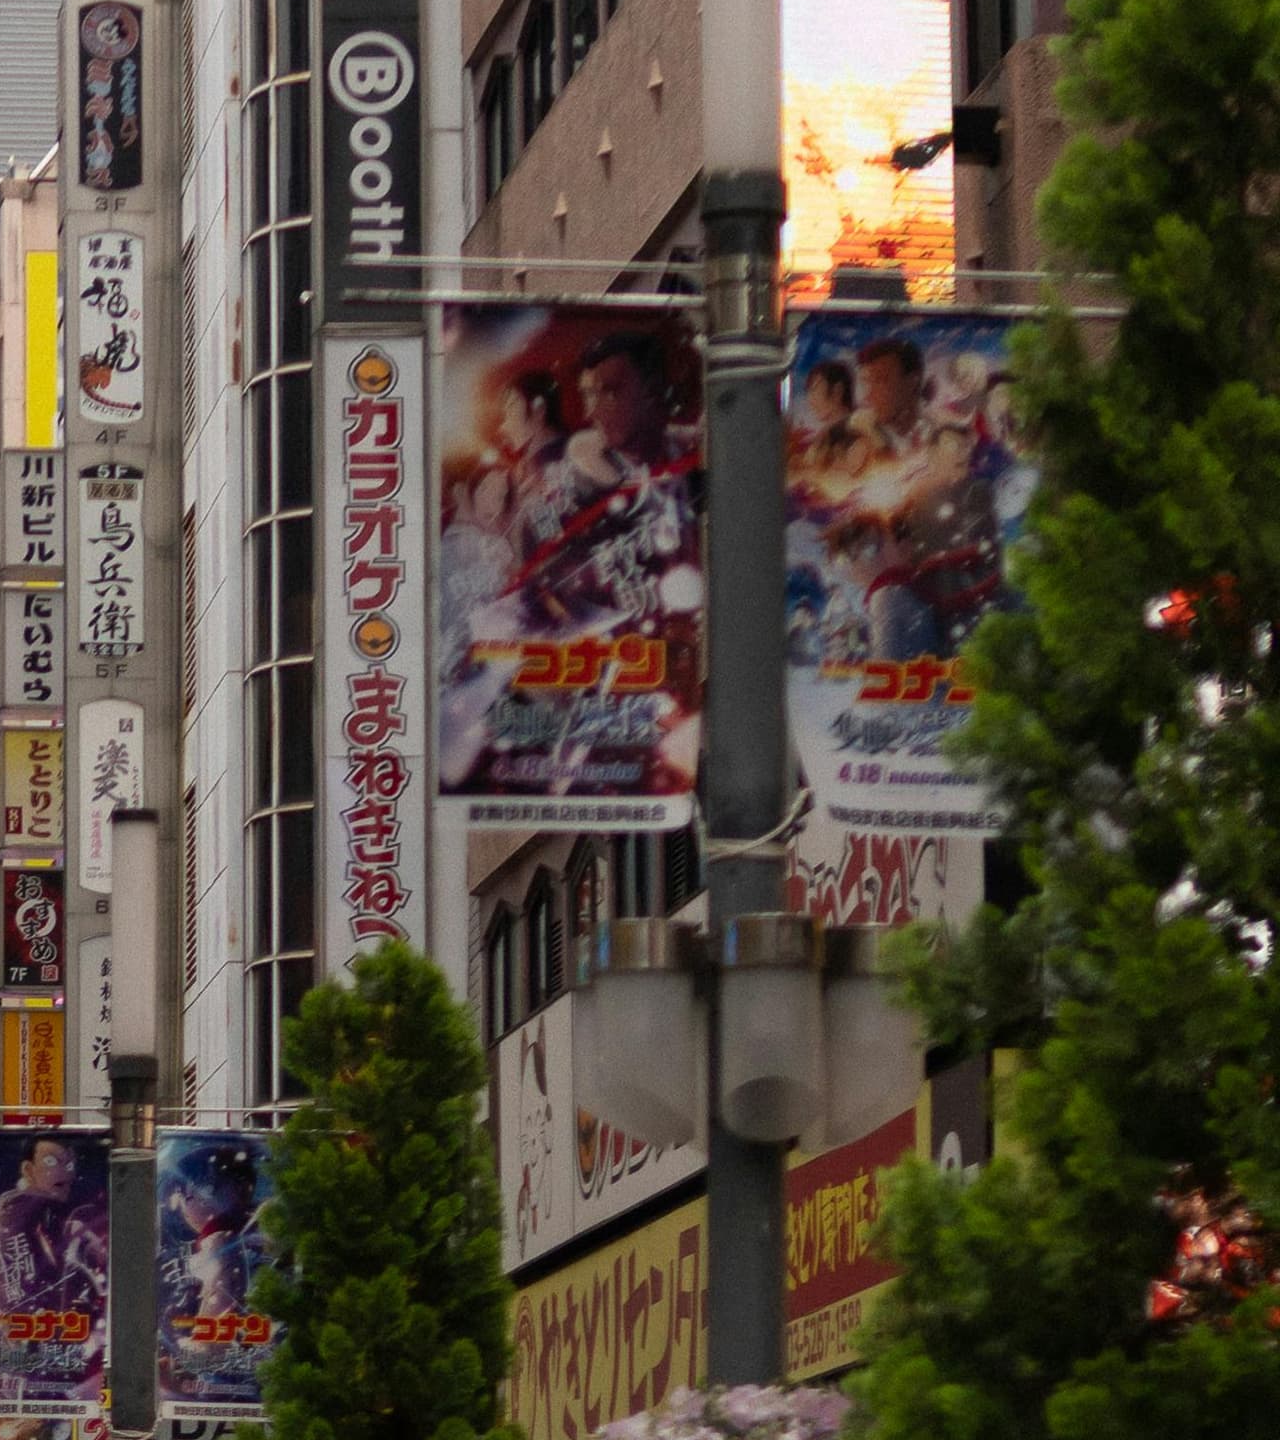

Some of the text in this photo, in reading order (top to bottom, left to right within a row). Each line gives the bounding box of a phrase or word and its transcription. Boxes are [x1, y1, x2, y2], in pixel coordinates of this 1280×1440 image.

[328, 31, 415, 260] Booth
[95, 428, 128, 445] 4F
[20, 455, 56, 563] 川新ビル
[343, 397, 405, 612] カラオケ
[87, 502, 136, 642] 鳥兵衛
[22, 593, 54, 702] にいむら
[95, 663, 129, 679] 5F
[16, 874, 57, 963] おすすめ
[10, 967, 28, 982] 7F
[7, 1311, 91, 1343] コナン
